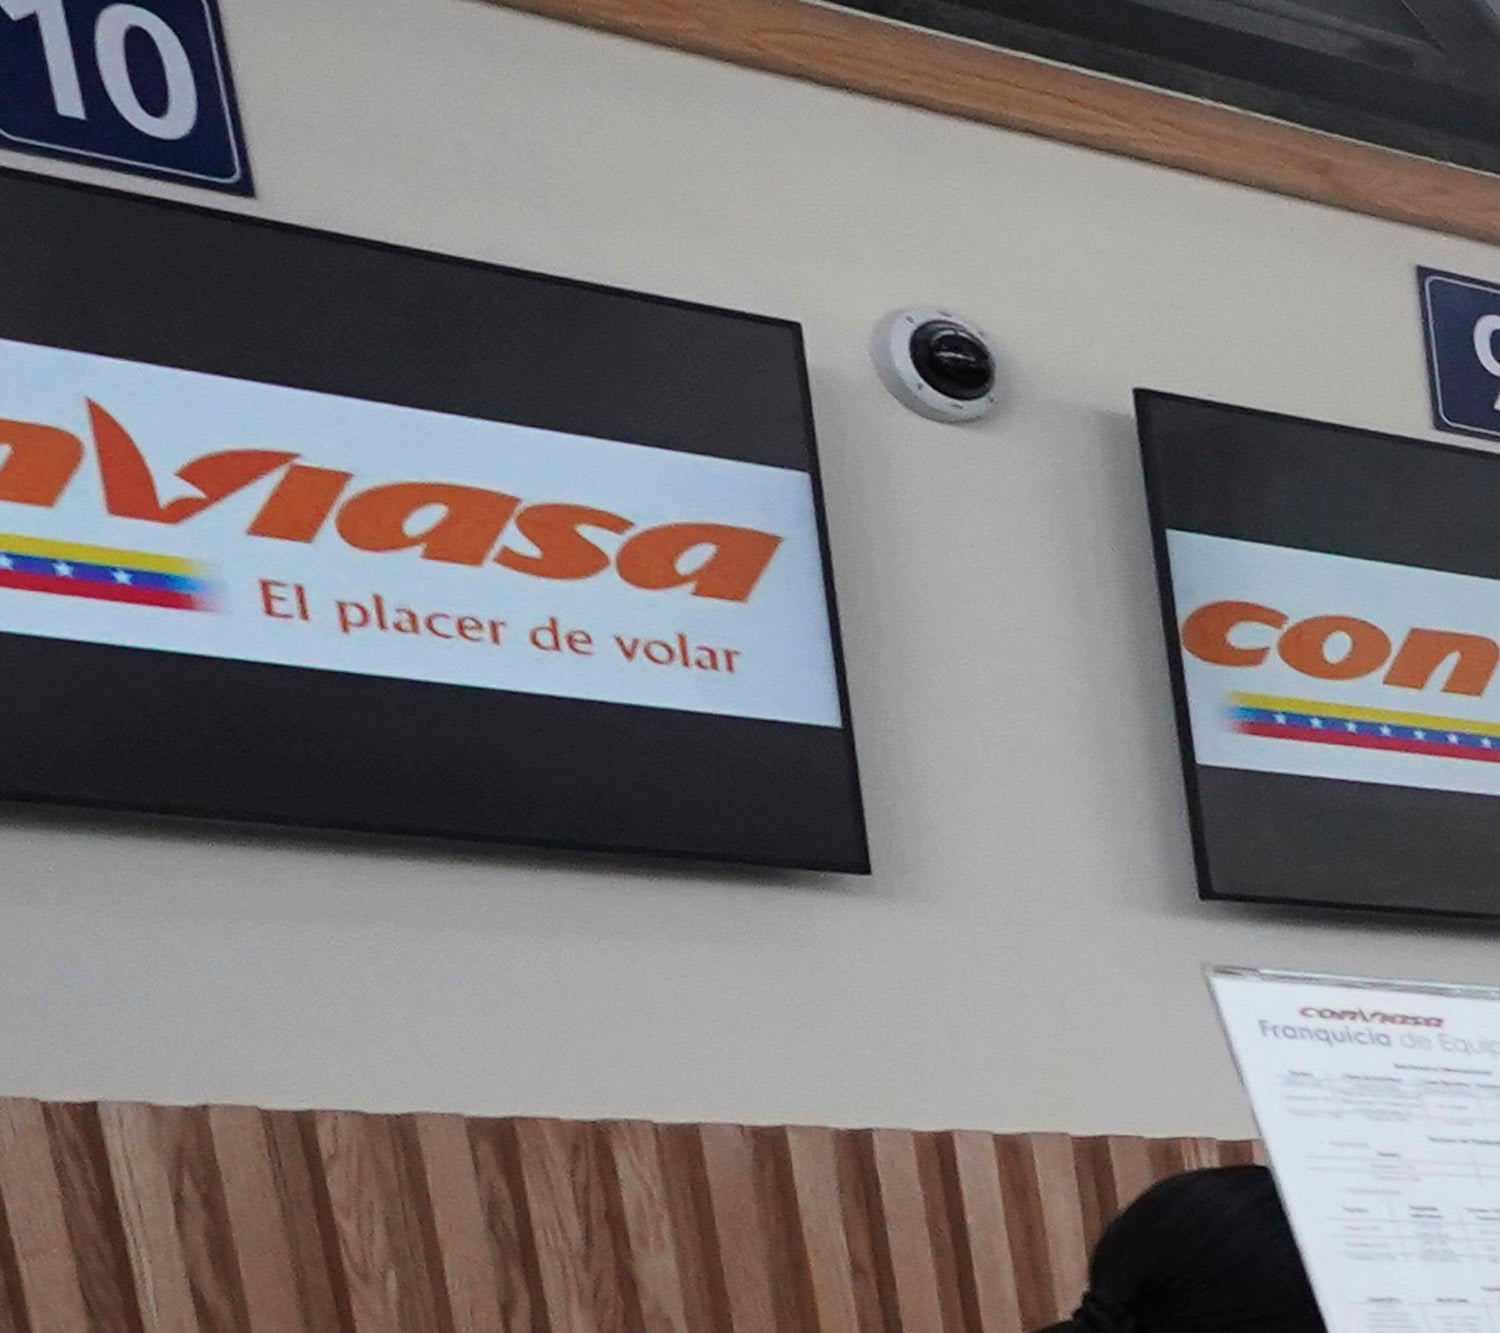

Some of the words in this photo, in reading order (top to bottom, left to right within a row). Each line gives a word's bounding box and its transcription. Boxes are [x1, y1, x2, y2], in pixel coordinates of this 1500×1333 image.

[0, 0, 196, 139] 10
[259, 580, 311, 622] El
[337, 595, 506, 646] placer
[530, 615, 594, 656] de
[616, 630, 741, 674] volar
[1258, 1019, 1393, 1048] Franquicia
